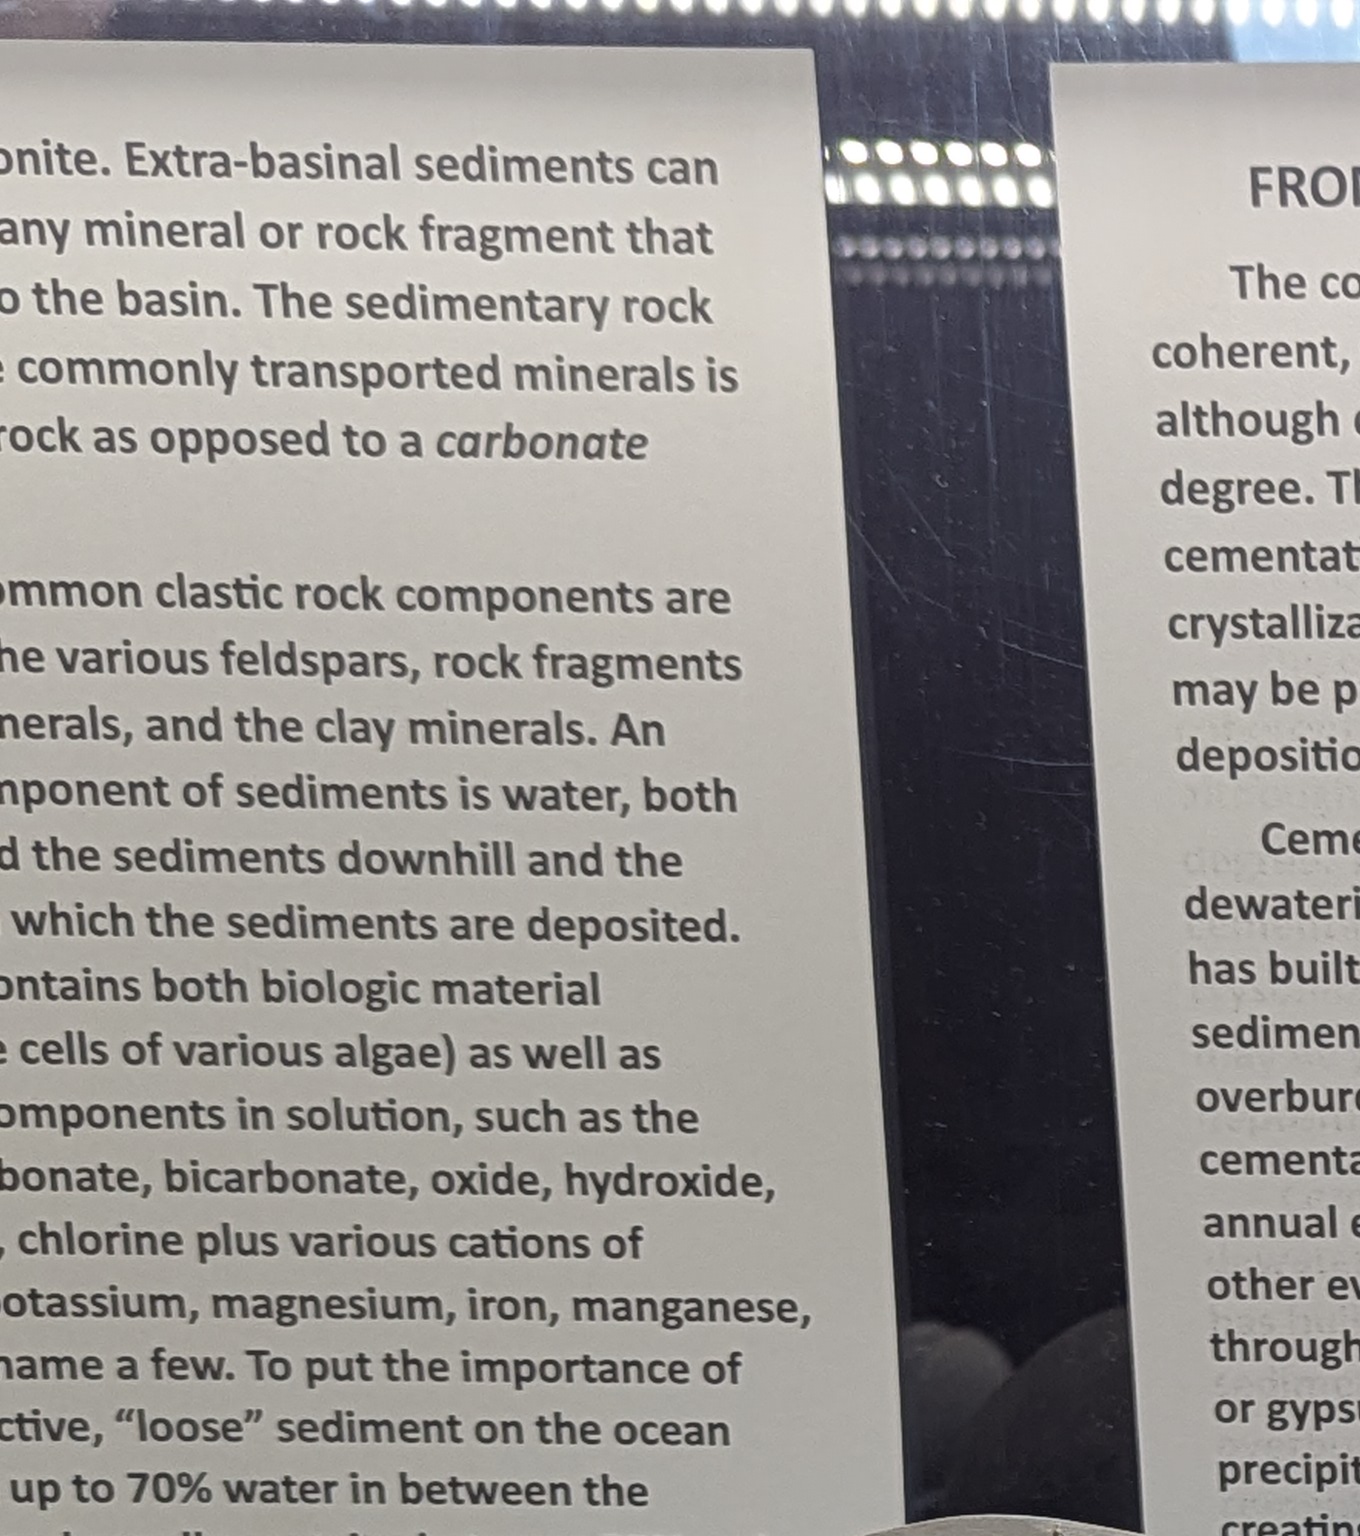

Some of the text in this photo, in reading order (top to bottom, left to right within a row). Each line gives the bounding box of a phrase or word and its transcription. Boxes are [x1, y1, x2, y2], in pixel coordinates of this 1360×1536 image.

[85, 210, 244, 248] mineral
[260, 222, 303, 249] or
[317, 213, 408, 250] rock
[419, 214, 614, 261] fragment
[626, 217, 713, 254] that
[1230, 263, 1306, 299] The
[1157, 400, 1339, 445] although
[10, 901, 739, 949] which the sediments are deposited.
[18, 1221, 643, 1264] chlorine plus various cations of
[10, 1472, 648, 1511] up to 70% water in between the
